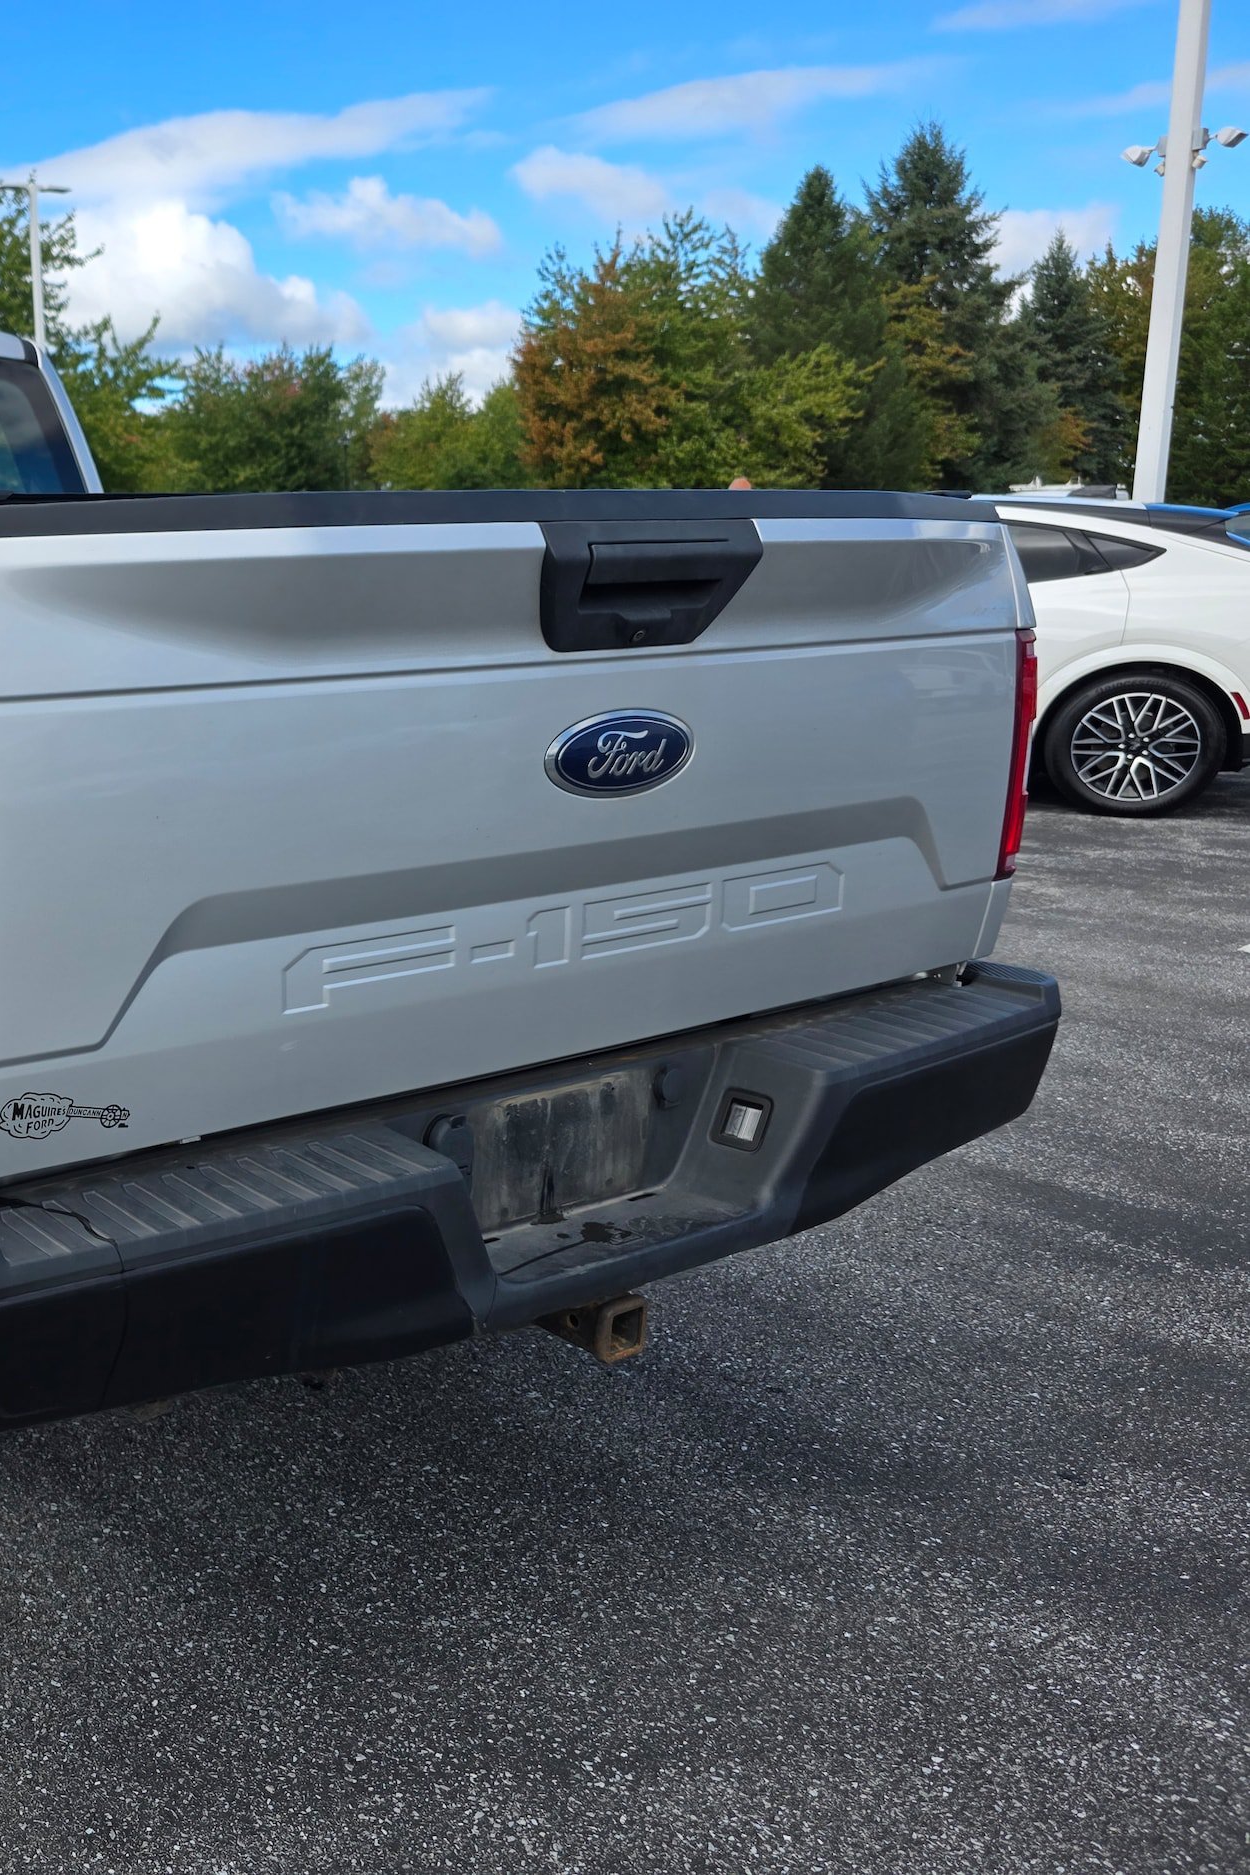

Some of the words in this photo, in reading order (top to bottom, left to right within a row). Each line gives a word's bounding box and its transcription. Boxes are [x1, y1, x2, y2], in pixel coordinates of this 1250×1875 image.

[587, 730, 667, 779] Ford
[281, 861, 845, 1014] F-150
[26, 1118, 55, 1134] FORD
